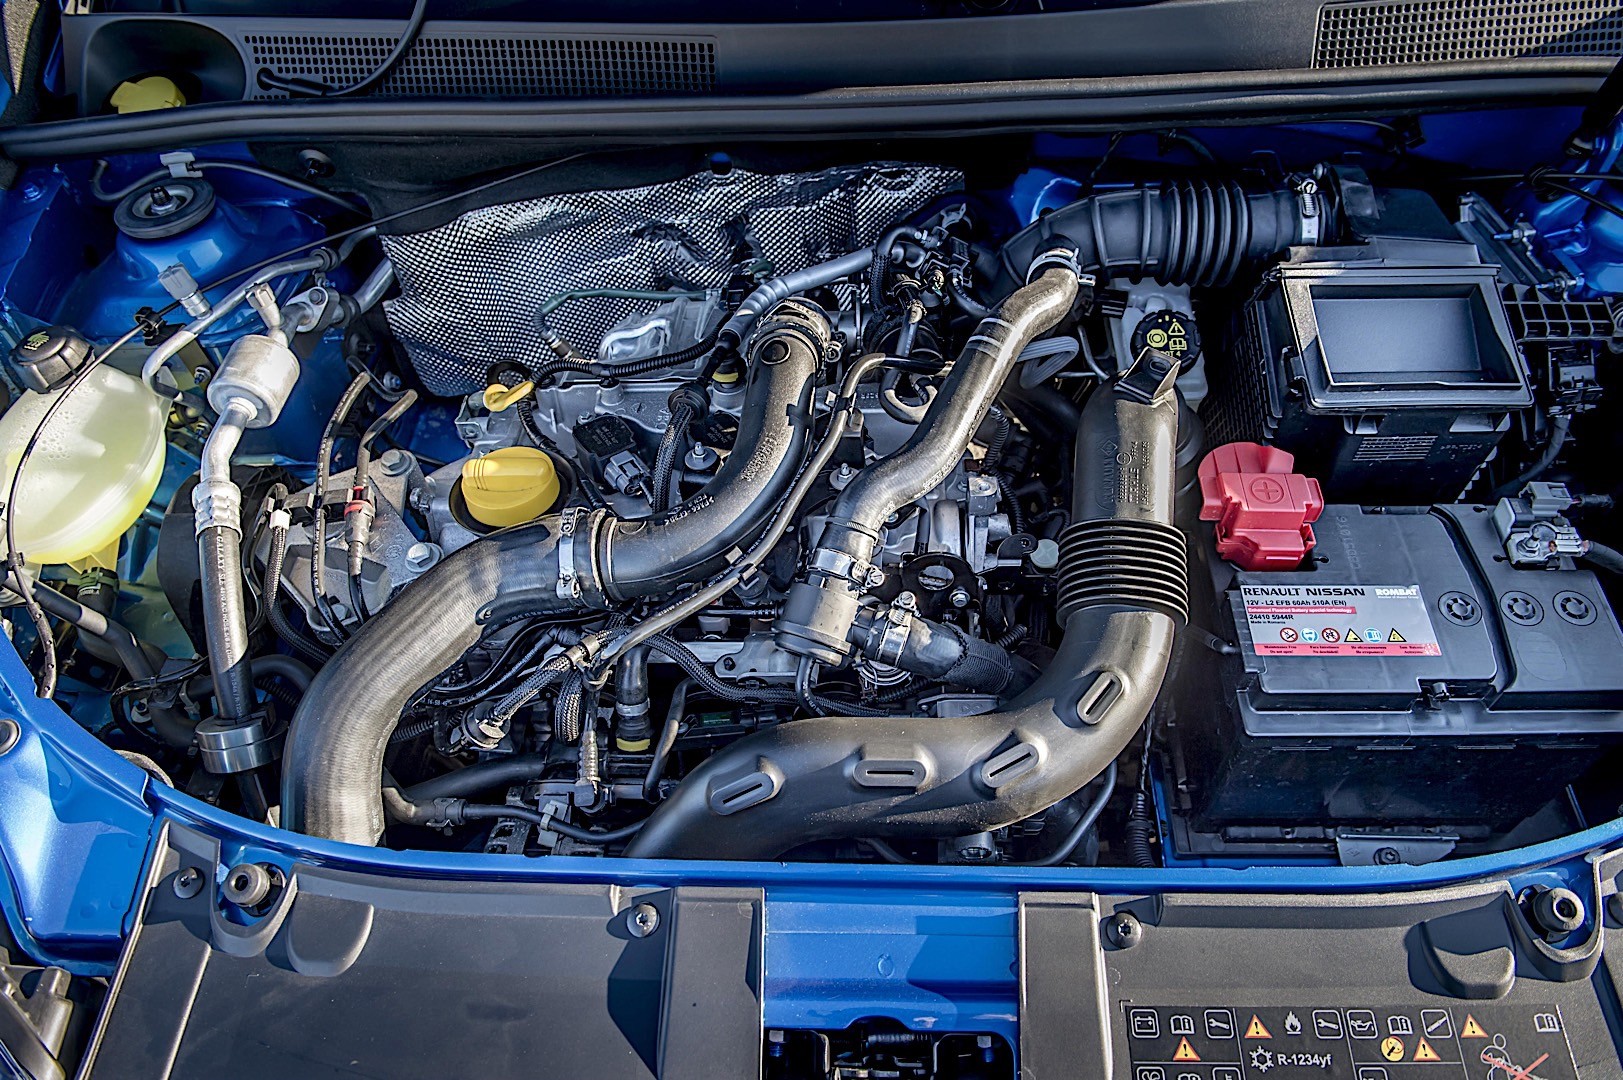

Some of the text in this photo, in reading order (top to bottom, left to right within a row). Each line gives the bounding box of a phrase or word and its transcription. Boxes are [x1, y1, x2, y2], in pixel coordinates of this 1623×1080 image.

[216, 535, 225, 571] GALAXY
[1243, 587, 1366, 596] RENAULT NISSAN
[1375, 588, 1418, 596] ROMBAT
[1277, 1053, 1332, 1068] R-1234yf
